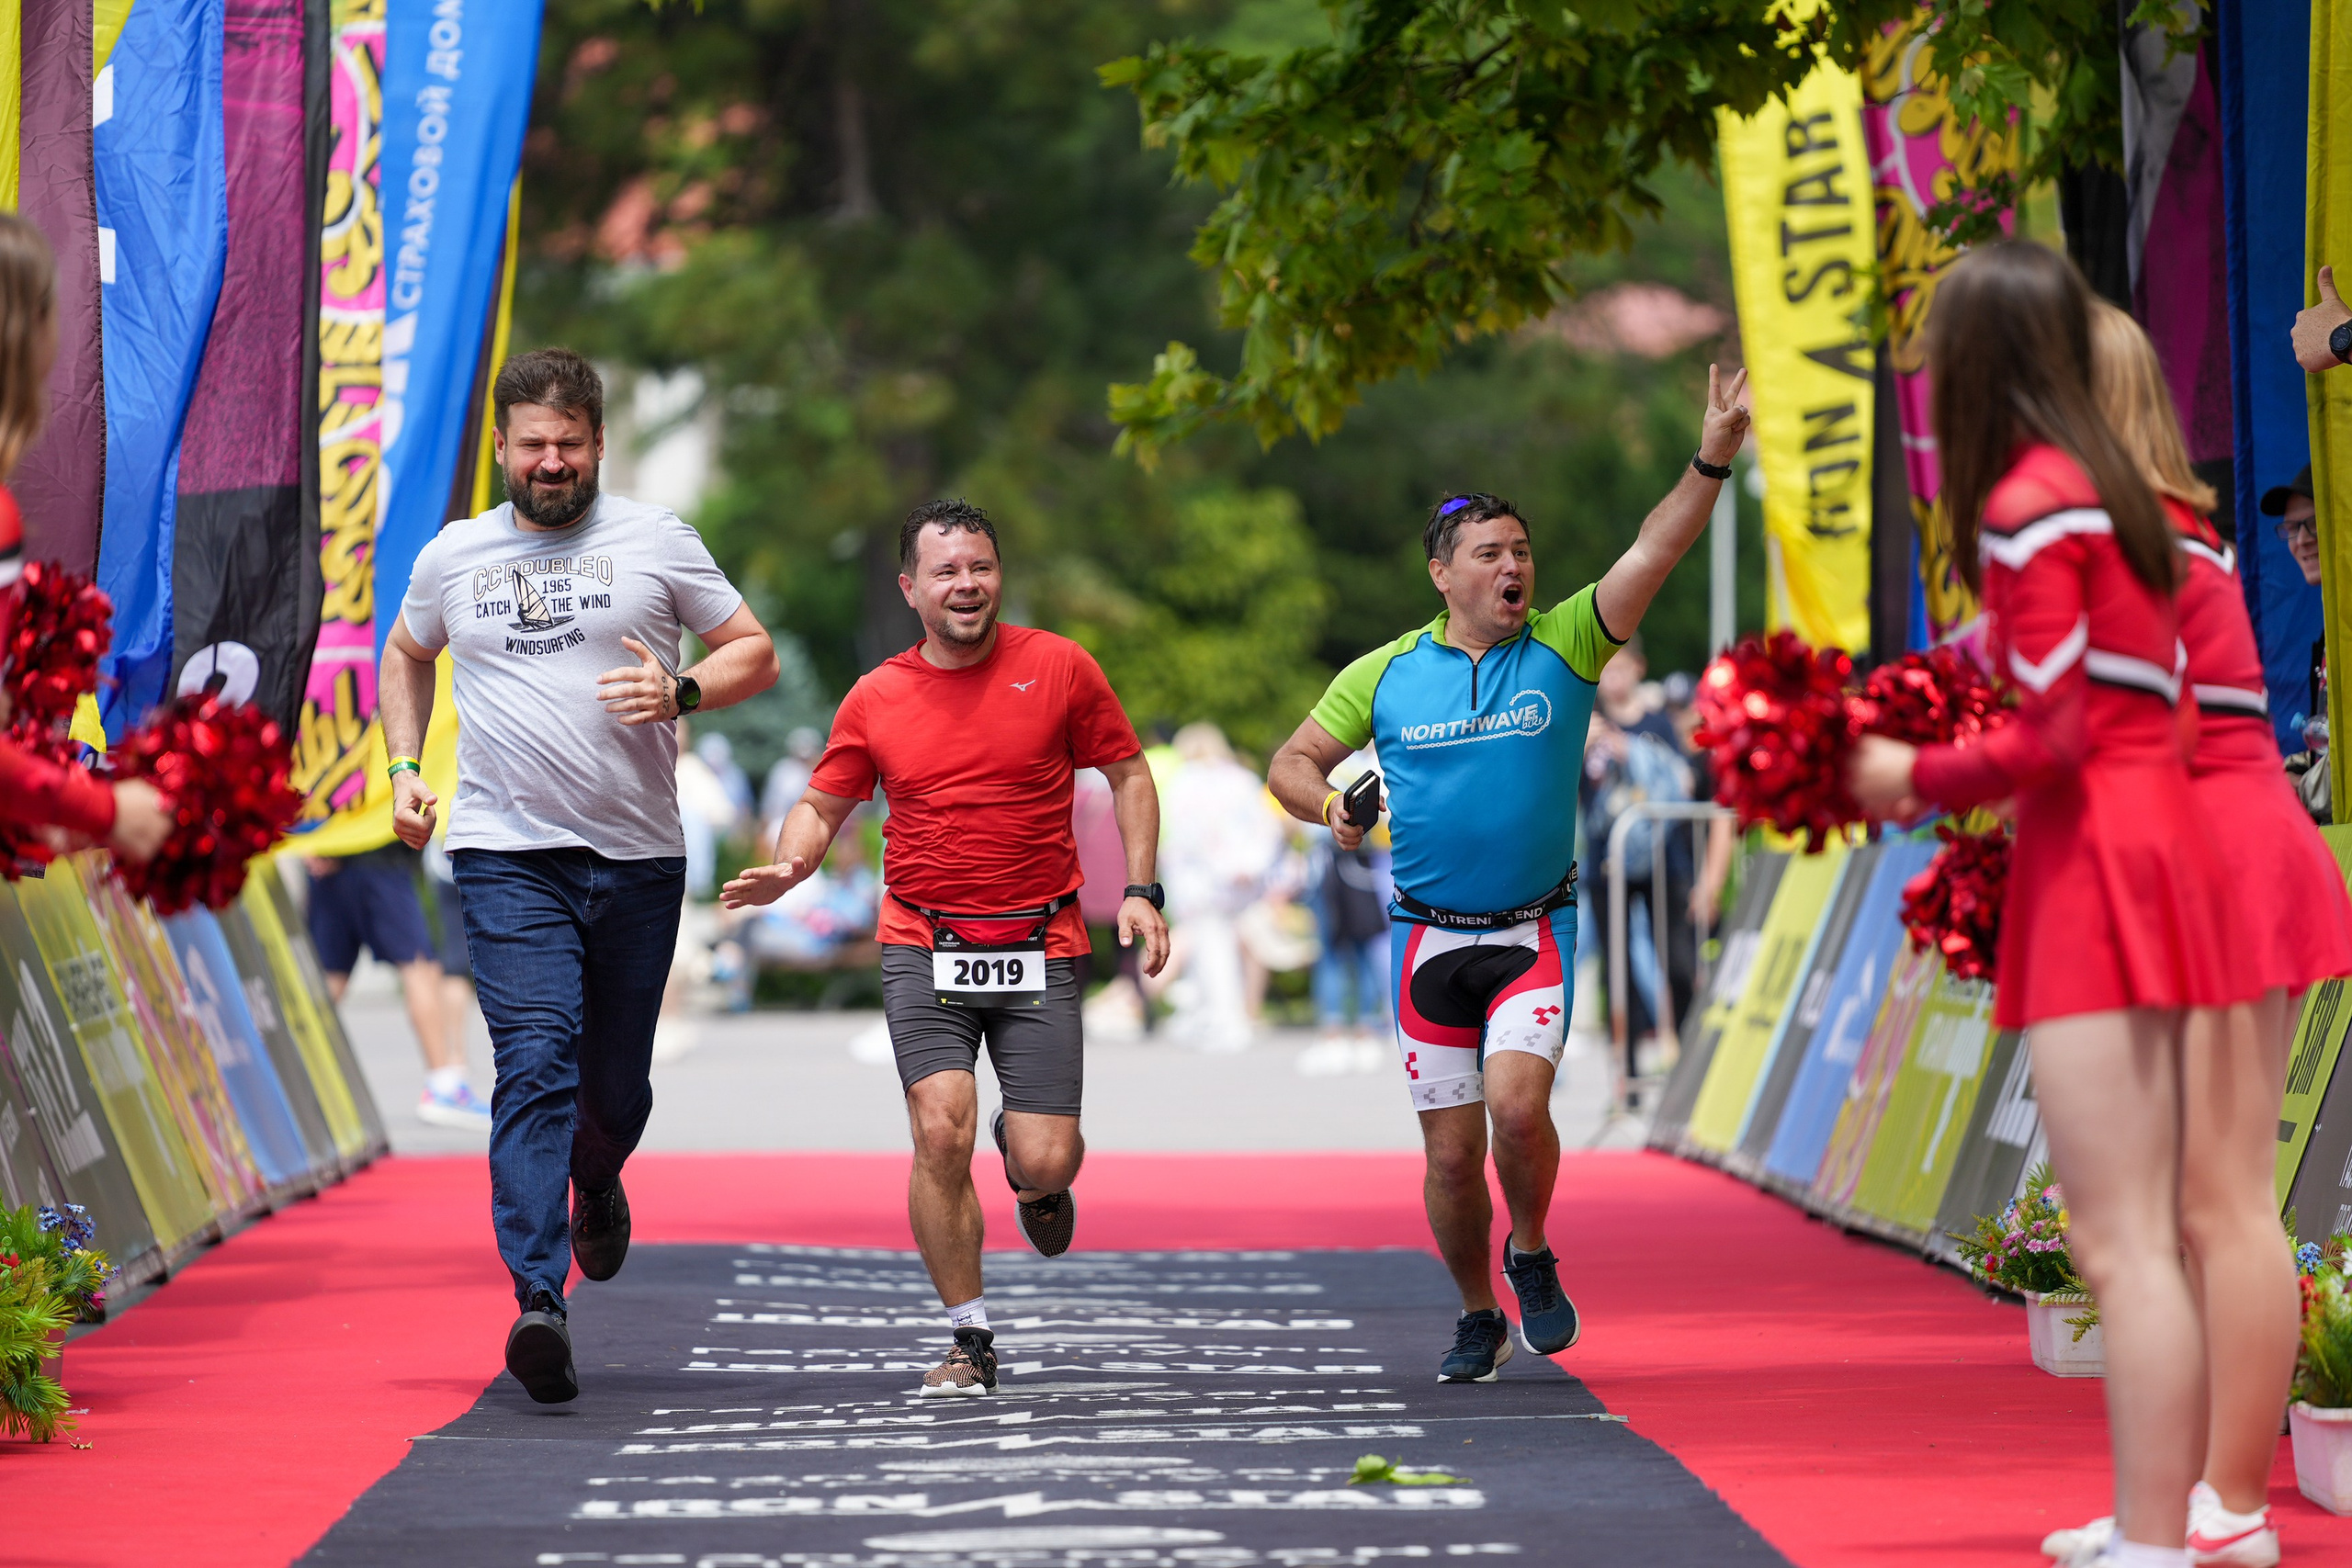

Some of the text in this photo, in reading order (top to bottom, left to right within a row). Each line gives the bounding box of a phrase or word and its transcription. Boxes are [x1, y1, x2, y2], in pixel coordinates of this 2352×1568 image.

[390, 85, 454, 310] СТРАХОВОЙ
[1781, 112, 1854, 304] STAR
[473, 565, 503, 602] CC
[504, 556, 594, 583] DOUBLE
[542, 579, 571, 594] 1965
[476, 593, 611, 618] CATCH THE WIND
[505, 627, 586, 656] WINDSURFING
[1401, 704, 1539, 742] NORTHWAVE
[1522, 713, 1544, 729] bike
[954, 958, 1024, 987] 2019
[1100, 1361, 1384, 1372] STAR
[641, 1403, 1408, 1433] IRON STAR
[619, 1426, 1426, 1453] IRON STAR
[1114, 1488, 1487, 1506] STAR
